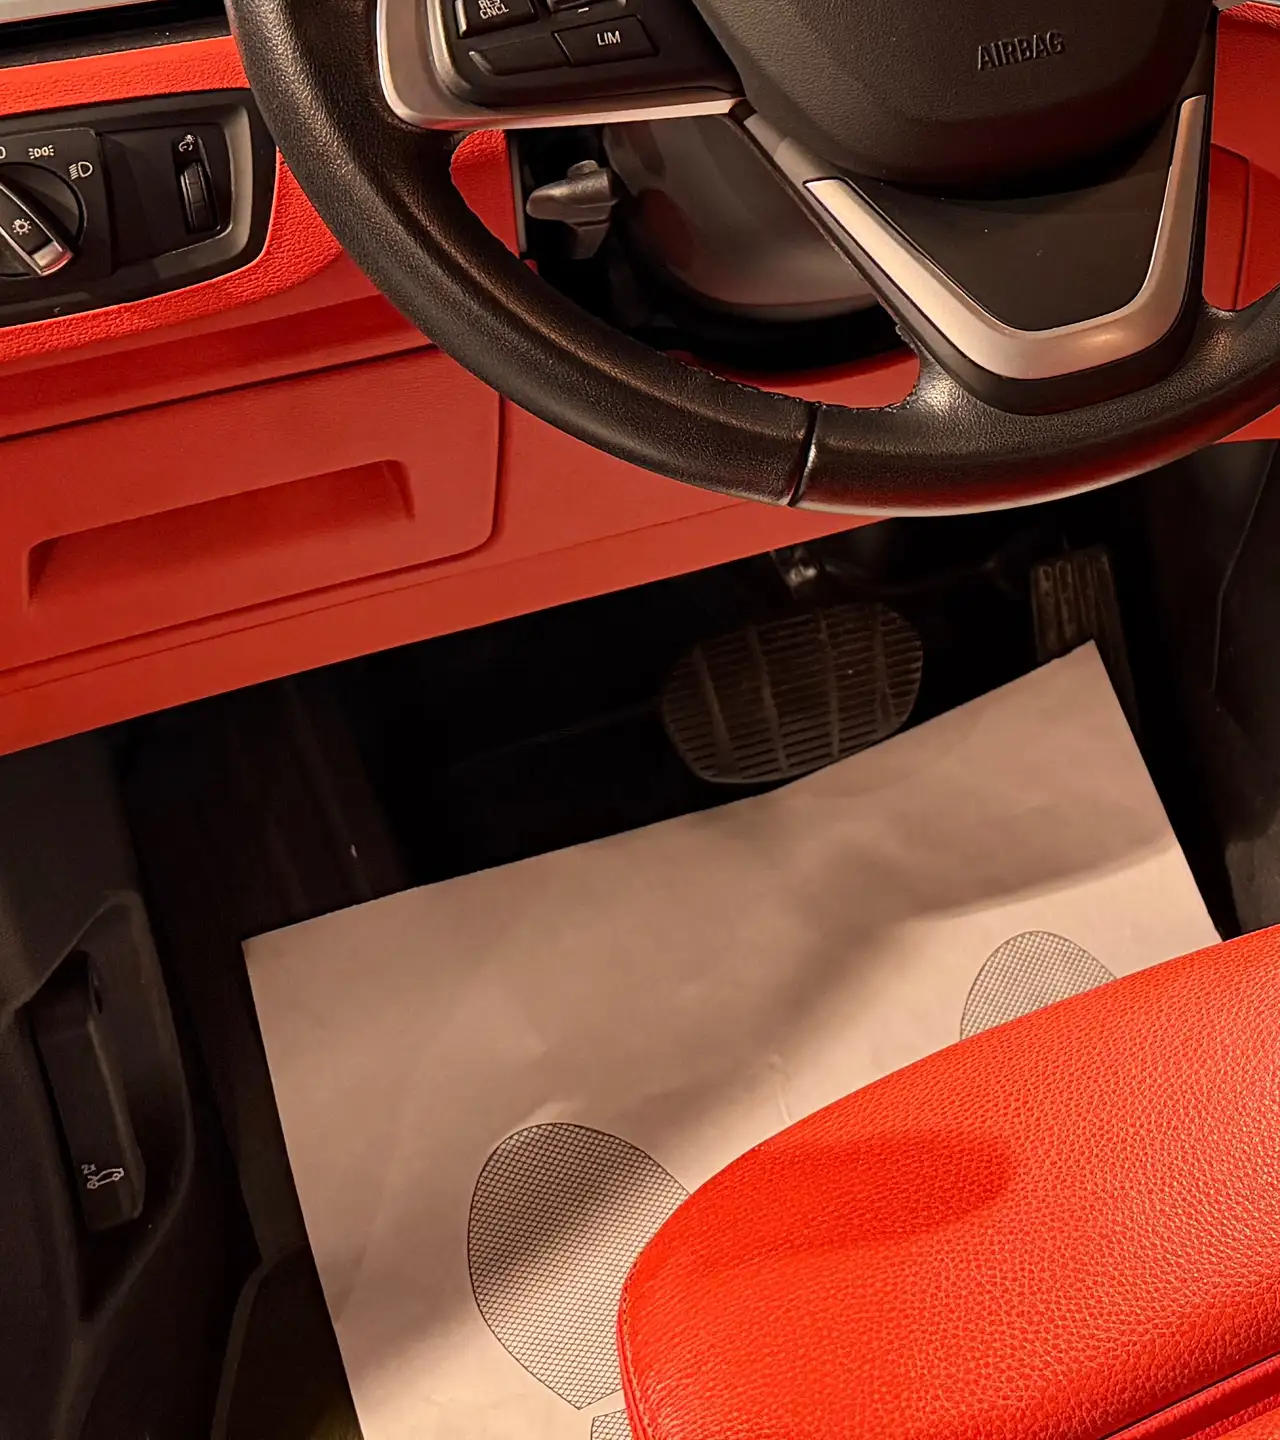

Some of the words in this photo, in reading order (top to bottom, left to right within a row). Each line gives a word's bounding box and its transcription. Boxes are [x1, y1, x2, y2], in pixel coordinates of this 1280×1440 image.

[479, 5, 510, 20] CNCL
[597, 30, 622, 46] LIM
[976, 30, 1067, 72] AIRBAG
